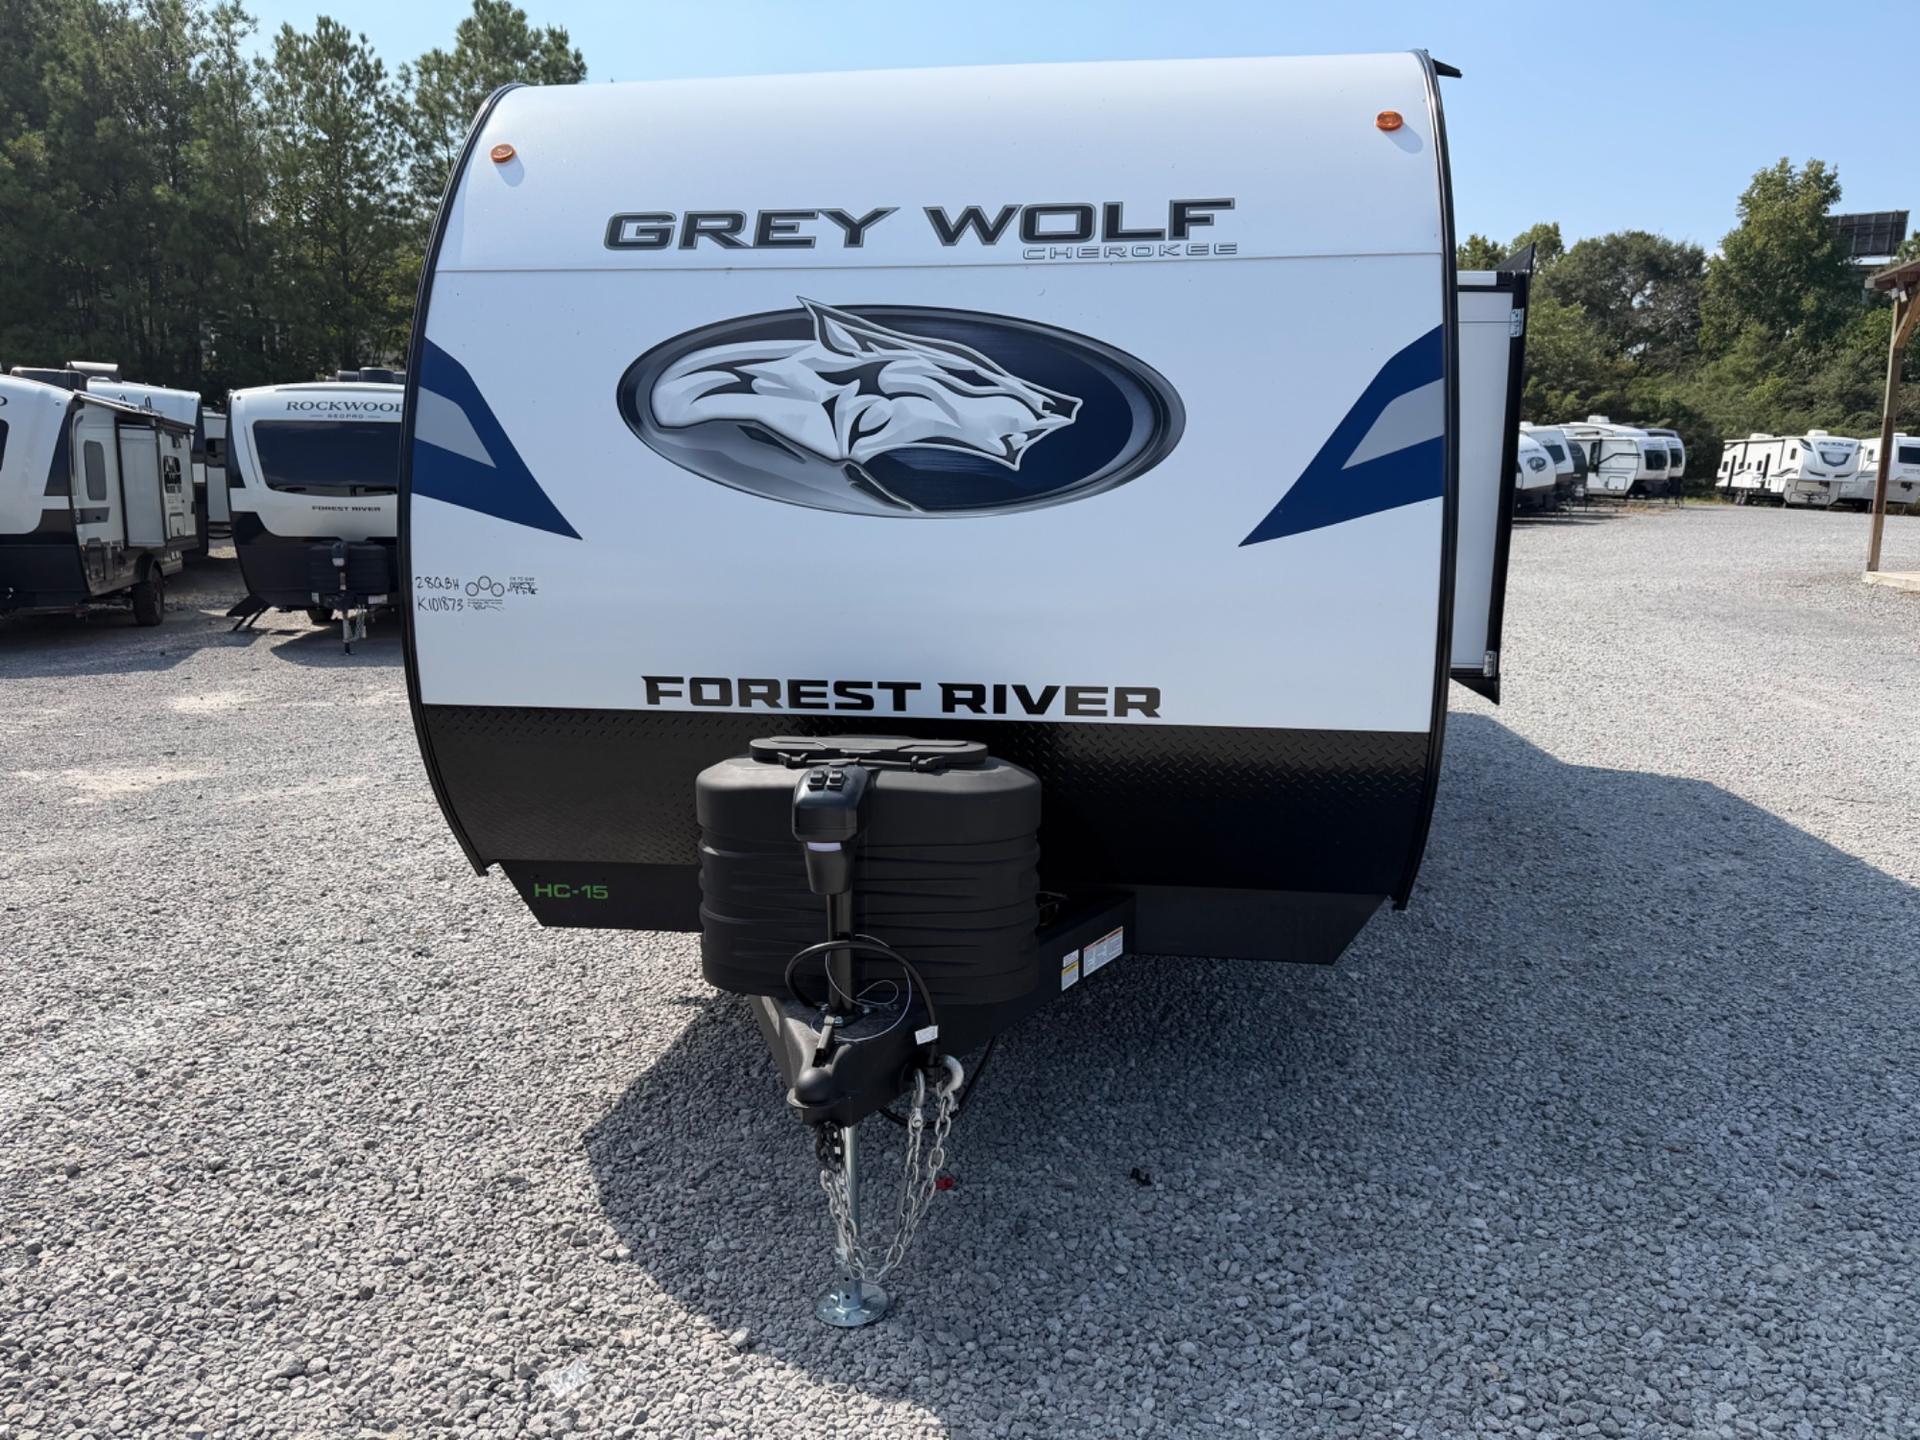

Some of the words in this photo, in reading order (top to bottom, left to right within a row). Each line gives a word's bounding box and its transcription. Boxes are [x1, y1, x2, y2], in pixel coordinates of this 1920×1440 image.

[604, 206, 901, 250] GREY
[922, 198, 1236, 246] WOLF
[1022, 242, 1238, 261] CHEROKEE
[641, 676, 921, 712] FOREST
[938, 682, 1162, 718] RIVER
[534, 883, 609, 900] HC-15
